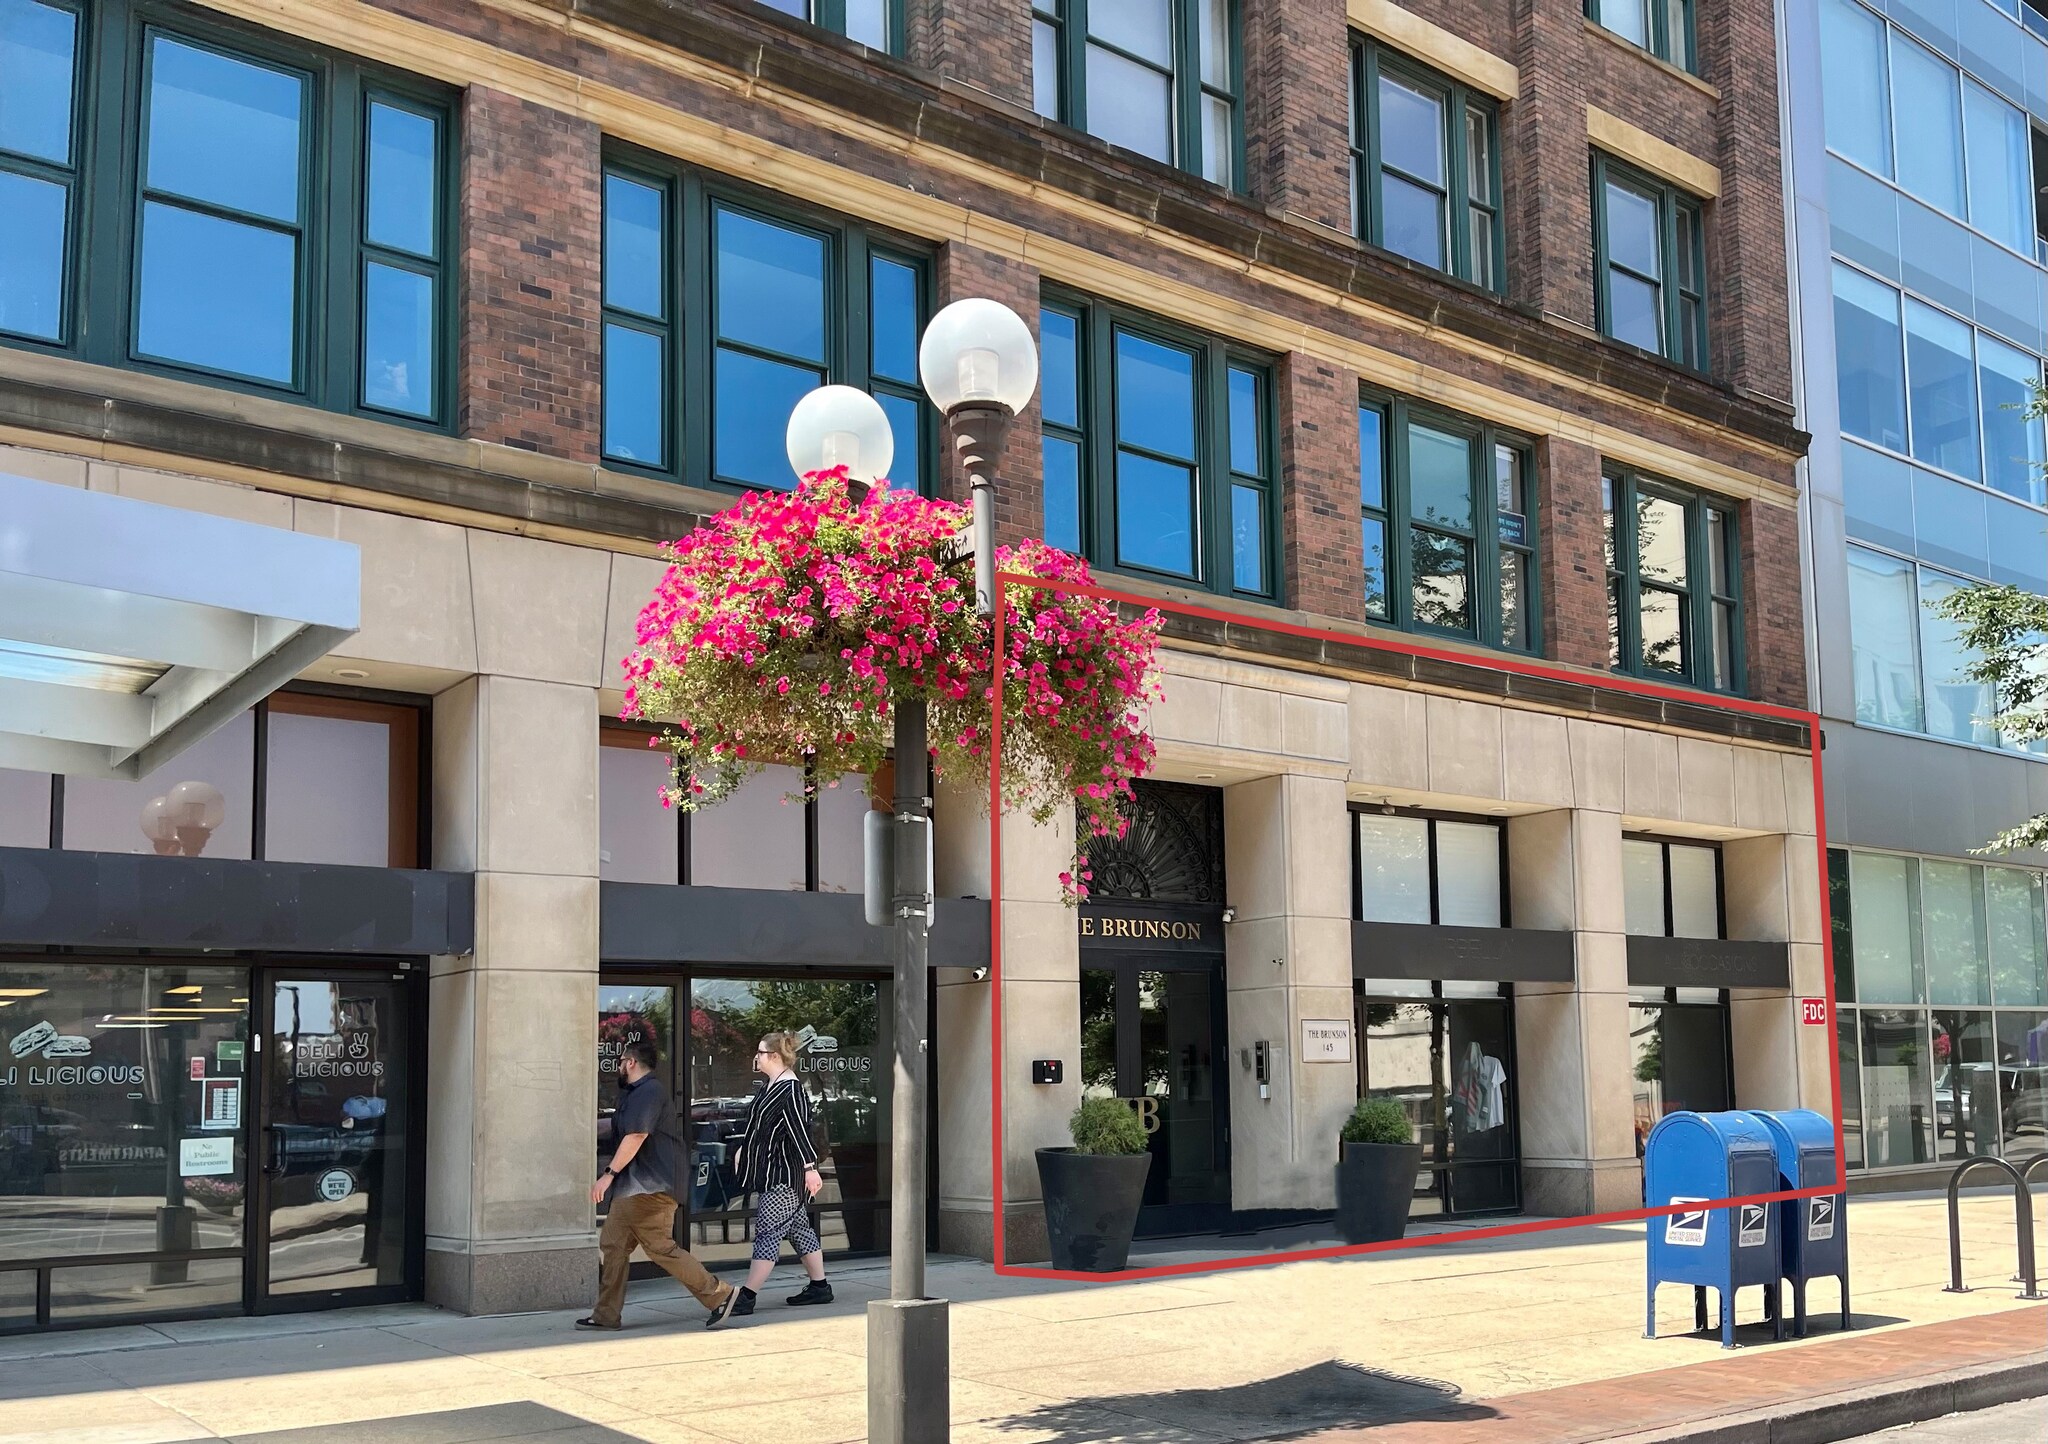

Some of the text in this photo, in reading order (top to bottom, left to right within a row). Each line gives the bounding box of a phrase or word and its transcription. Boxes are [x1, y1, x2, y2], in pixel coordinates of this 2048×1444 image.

[1101, 918, 1201, 940] BRUNSON
[1803, 1003, 1825, 1021] FDC
[1308, 1030, 1347, 1039] THE BRUNSON
[296, 1043, 345, 1059] DELI
[598, 1042, 622, 1056] ELI
[1322, 1043, 1334, 1052] 145
[295, 1061, 384, 1078] LICIOUS
[800, 1056, 871, 1073] LICIOUS
[28, 1065, 145, 1085] LICIOUS
[194, 1151, 220, 1159] Public
[185, 1160, 228, 1168] Restrooms
